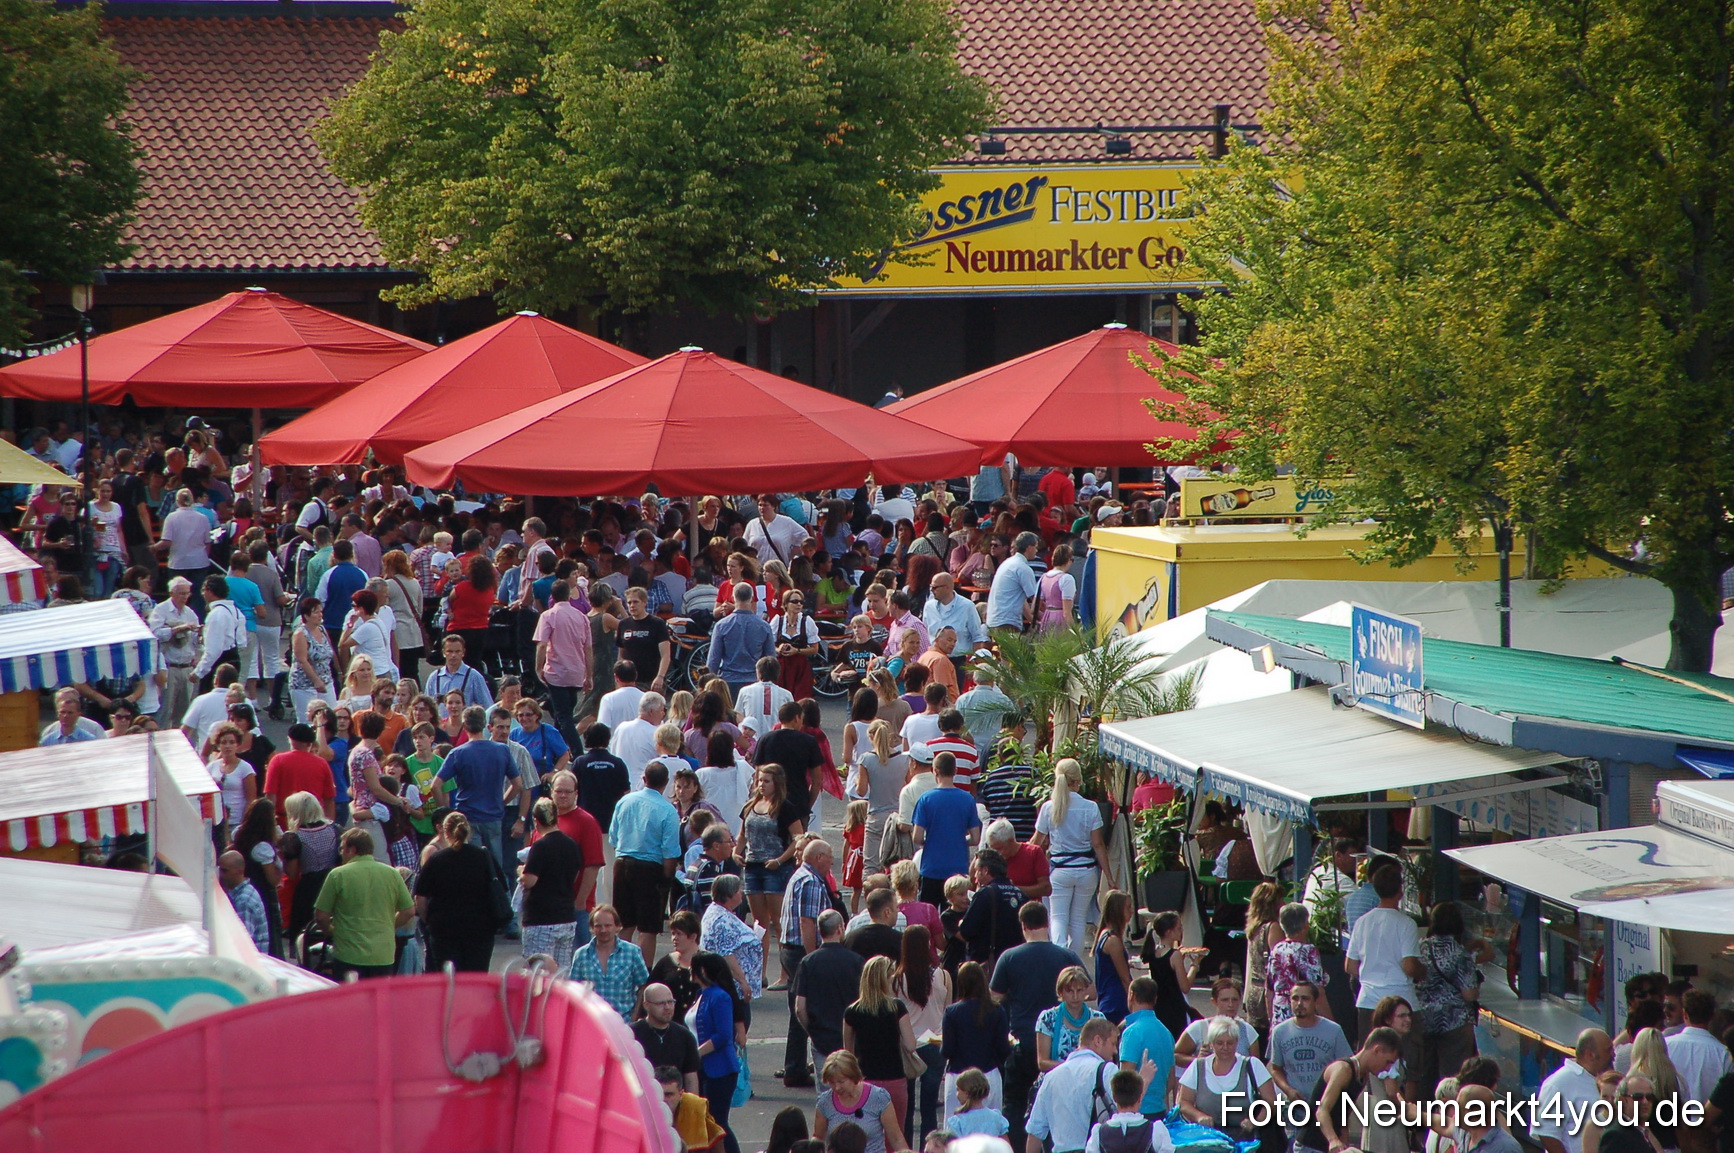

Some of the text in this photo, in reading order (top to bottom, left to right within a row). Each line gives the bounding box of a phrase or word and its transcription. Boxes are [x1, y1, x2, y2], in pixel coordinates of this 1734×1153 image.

[944, 238, 1133, 273] Neumarkter
[1369, 618, 1404, 666] FISCH
[1616, 919, 1651, 955] Original
[1305, 1035, 1333, 1054] VALLEY
